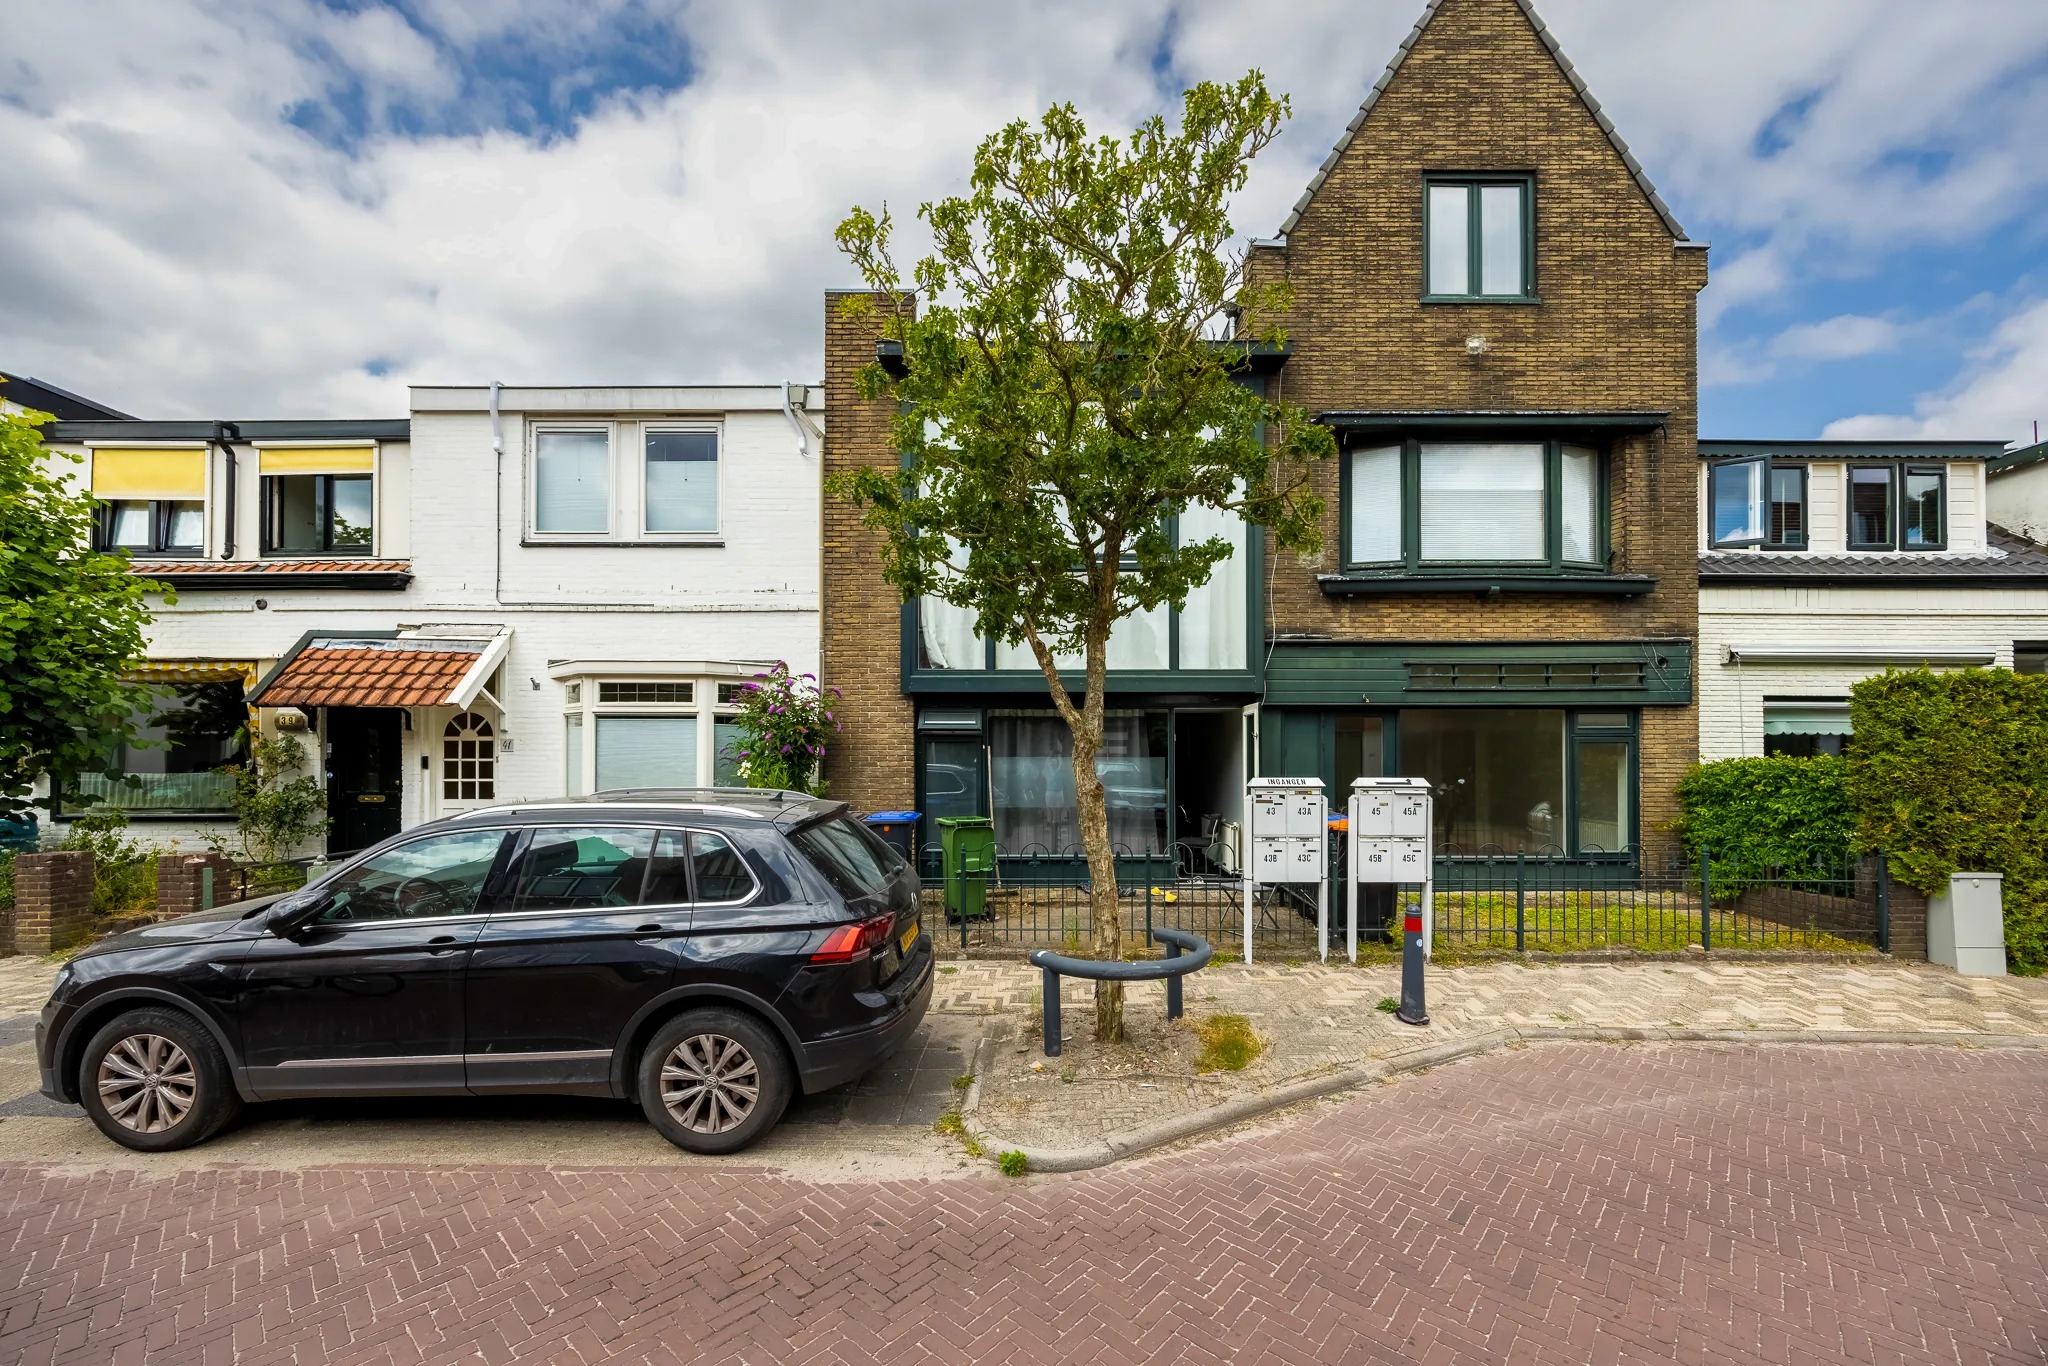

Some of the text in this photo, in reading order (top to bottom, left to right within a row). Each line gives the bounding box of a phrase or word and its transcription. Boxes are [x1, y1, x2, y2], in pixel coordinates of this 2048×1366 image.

[281, 716, 293, 724] 39
[1266, 807, 1276, 815] 43
[1297, 807, 1312, 815] 43A
[1371, 807, 1381, 815] 45
[1402, 807, 1417, 815] 45A
[1263, 854, 1277, 862] 43B
[1297, 854, 1311, 862] 43C
[1368, 854, 1382, 862] 45B
[1402, 854, 1416, 862] 45C
